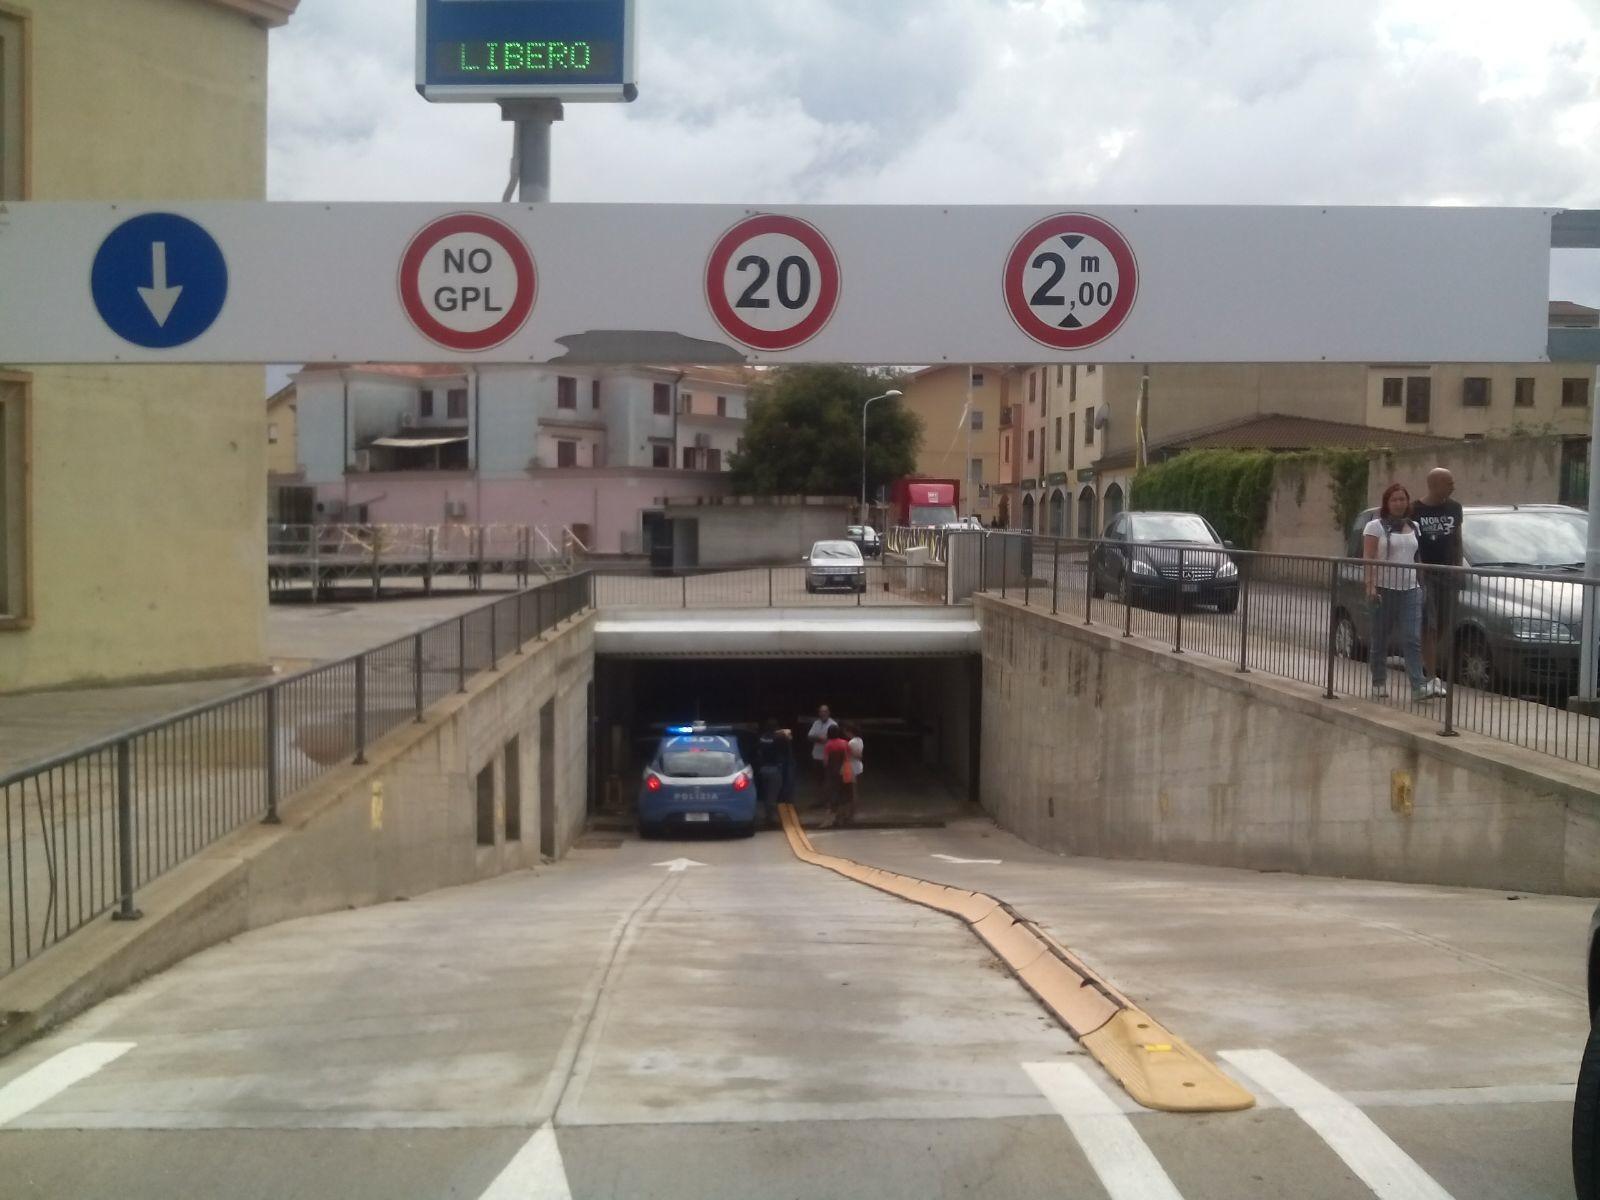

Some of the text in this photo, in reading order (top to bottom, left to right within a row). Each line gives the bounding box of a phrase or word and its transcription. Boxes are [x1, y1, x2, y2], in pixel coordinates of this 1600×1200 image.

[460, 41, 591, 70] LIBERO
[443, 248, 492, 274] NO
[1080, 255, 1100, 273] m
[735, 255, 811, 310] 20
[434, 286, 503, 312] GPL
